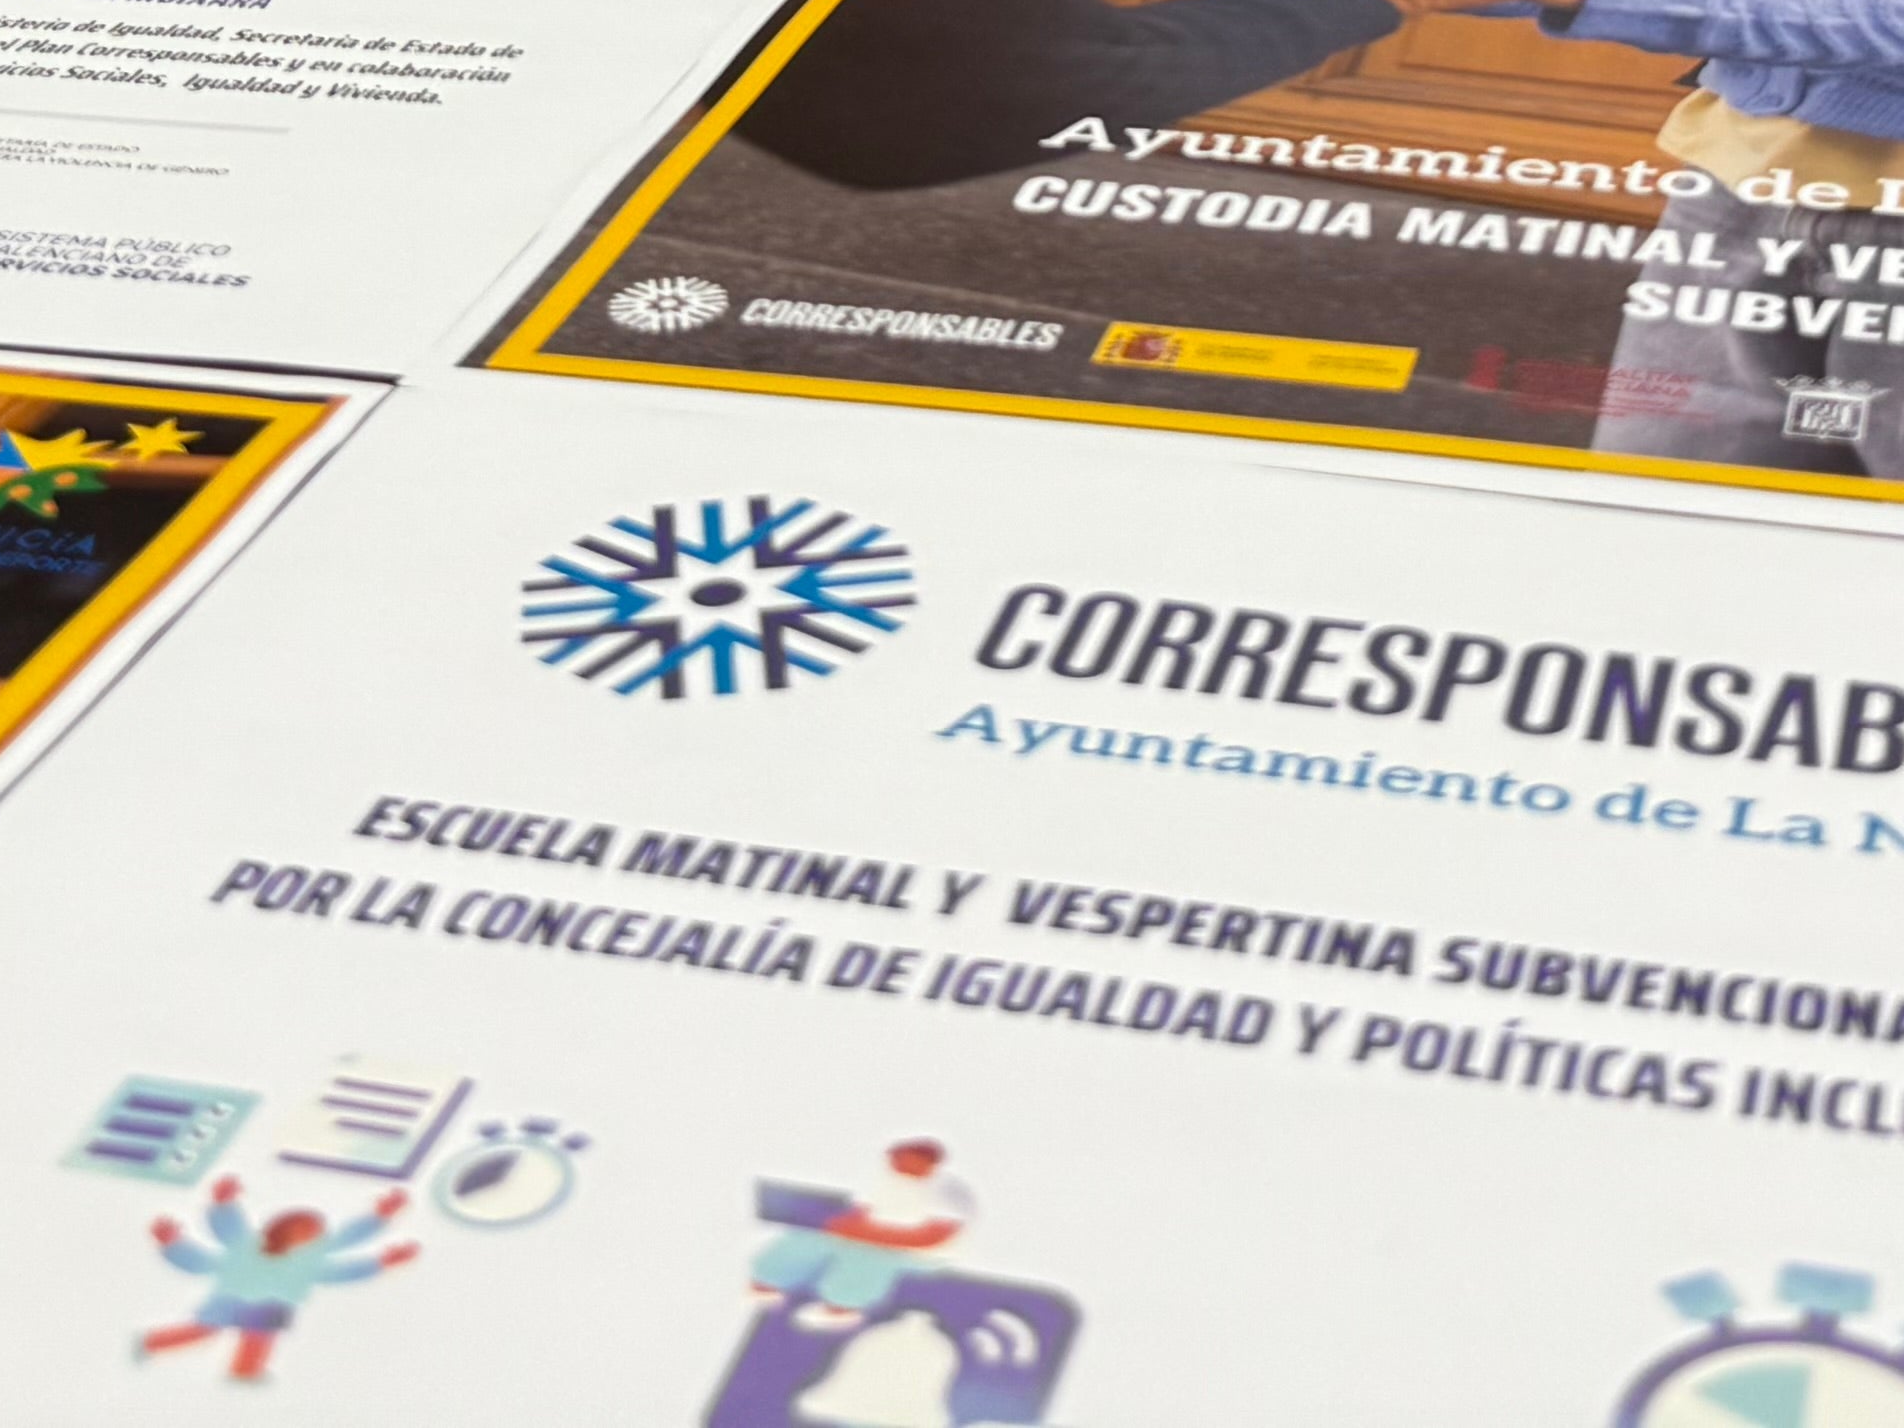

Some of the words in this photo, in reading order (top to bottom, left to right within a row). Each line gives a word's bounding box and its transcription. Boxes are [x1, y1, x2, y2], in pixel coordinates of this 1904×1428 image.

[72, 18, 106, 34] de
[362, 36, 396, 52] de
[399, 38, 486, 57] Estado
[489, 43, 524, 59] de
[1037, 113, 1711, 200] Ayuntamiento
[1733, 163, 1853, 210] de
[1013, 175, 1371, 238] CUSTODIA
[1396, 206, 1726, 270] MATINAL
[1756, 236, 1804, 275] Y
[110, 265, 251, 288] SOCIALES
[740, 296, 1064, 351] CORRESPONSABLES
[933, 703, 1573, 815] Ayuntamiento
[1592, 782, 1701, 832] de
[1721, 795, 1828, 849] La
[351, 795, 615, 868] ESCUELA
[618, 831, 915, 912] MATINAL
[936, 870, 984, 917] Y
[1006, 879, 1416, 979] VESPERTINA
[208, 858, 352, 919] POR
[347, 876, 437, 931] LA
[440, 889, 815, 984] CONCEJALÍA
[822, 941, 921, 997] DE
[921, 953, 1276, 1049] IGUALDAD
[1296, 1004, 1342, 1057] Y
[1349, 1013, 1718, 1114] POLÍTICAS
